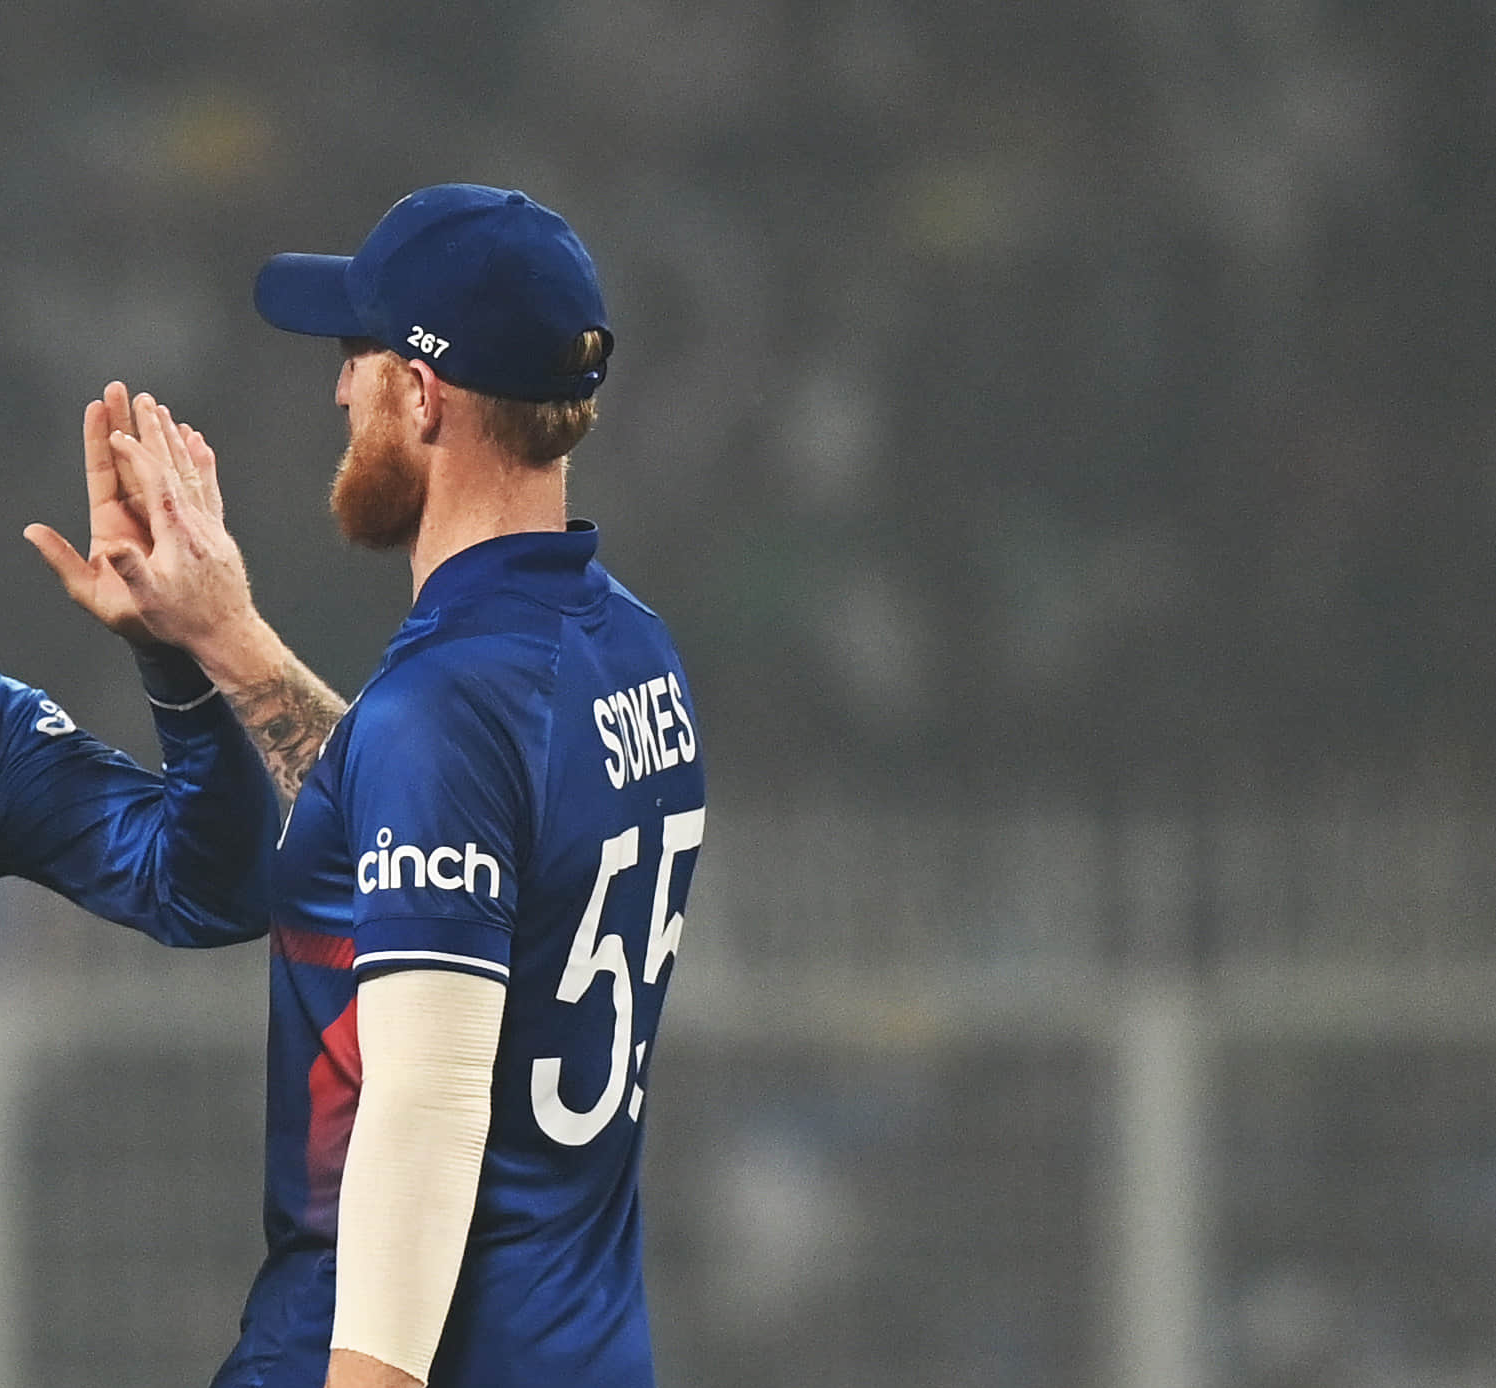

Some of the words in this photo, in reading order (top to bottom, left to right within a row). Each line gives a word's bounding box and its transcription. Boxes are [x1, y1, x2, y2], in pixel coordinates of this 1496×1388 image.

[407, 325, 450, 359] 267
[593, 671, 696, 790] STOKES
[357, 826, 501, 899] cinch
[530, 805, 707, 1146] 55
